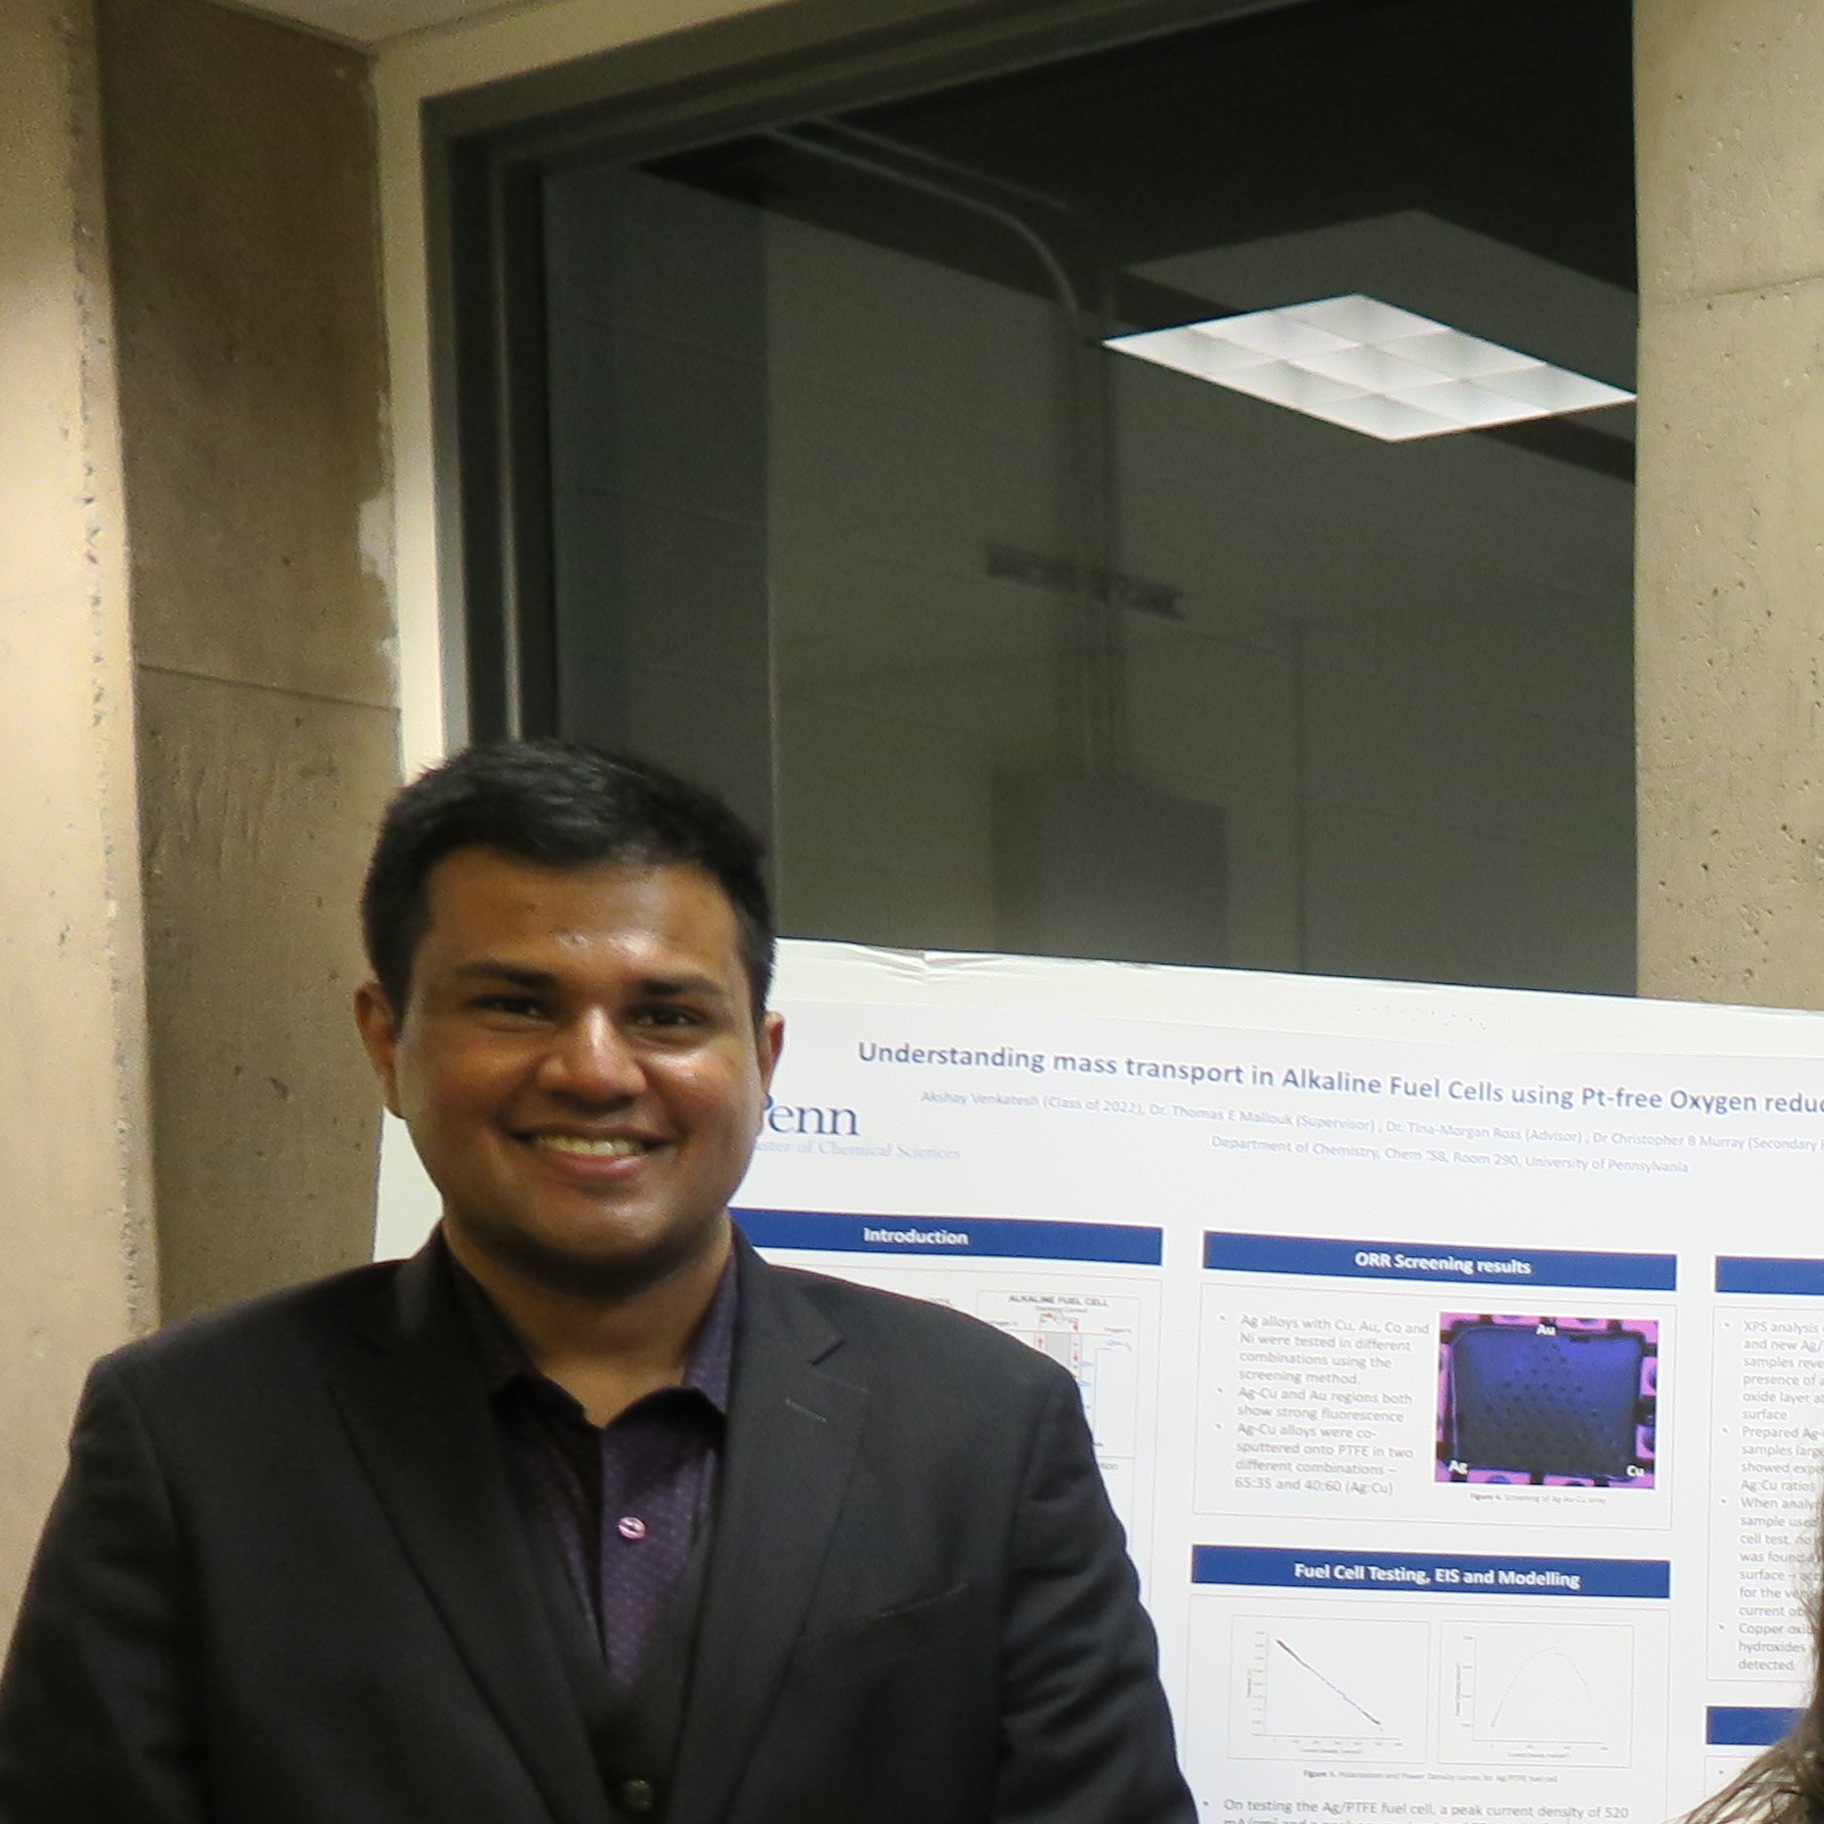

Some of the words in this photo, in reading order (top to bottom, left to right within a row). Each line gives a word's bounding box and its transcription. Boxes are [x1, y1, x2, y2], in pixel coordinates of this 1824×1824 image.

[858, 1042, 1044, 1073] Understanding
[1054, 1055, 1116, 1073] mass
[1125, 1058, 1243, 1084] transport
[1252, 1065, 1273, 1085] in
[1282, 1068, 1381, 1093] Alkaline
[1390, 1076, 1439, 1097] Fuel
[1448, 1080, 1502, 1101] Cells
[1512, 1085, 1573, 1109] using
[1582, 1087, 1661, 1108] Pt-free
[1670, 1090, 1756, 1114] Oxygen
[863, 1227, 968, 1244] Introduction
[1355, 1251, 1391, 1267] ORR
[1393, 1253, 1473, 1274] Screening
[1476, 1259, 1531, 1274] results
[1536, 1324, 1556, 1336] Au
[1281, 1389, 1305, 1400] and
[1309, 1390, 1327, 1401] Au
[1331, 1392, 1378, 1404] regions
[1382, 1392, 1412, 1404] both
[1236, 1404, 1272, 1416] show
[1276, 1407, 1317, 1421] strong
[1626, 1465, 1645, 1477] Cu
[1294, 1563, 1330, 1579] Fuel
[1333, 1564, 1364, 1579] Cell
[1367, 1566, 1431, 1585] Testing,
[1435, 1568, 1460, 1583] EIS
[1462, 1569, 1494, 1583] and
[1498, 1570, 1580, 1589] Modelling
[1223, 1798, 1243, 1810] On
[1247, 1800, 1292, 1819] testing
[1296, 1800, 1318, 1814] the
[1381, 1802, 1406, 1814] fuel
[1451, 1804, 1483, 1823] peak
[1486, 1807, 1533, 1816] current
[1537, 1806, 1583, 1823] density
[1587, 1806, 1600, 1817] of
